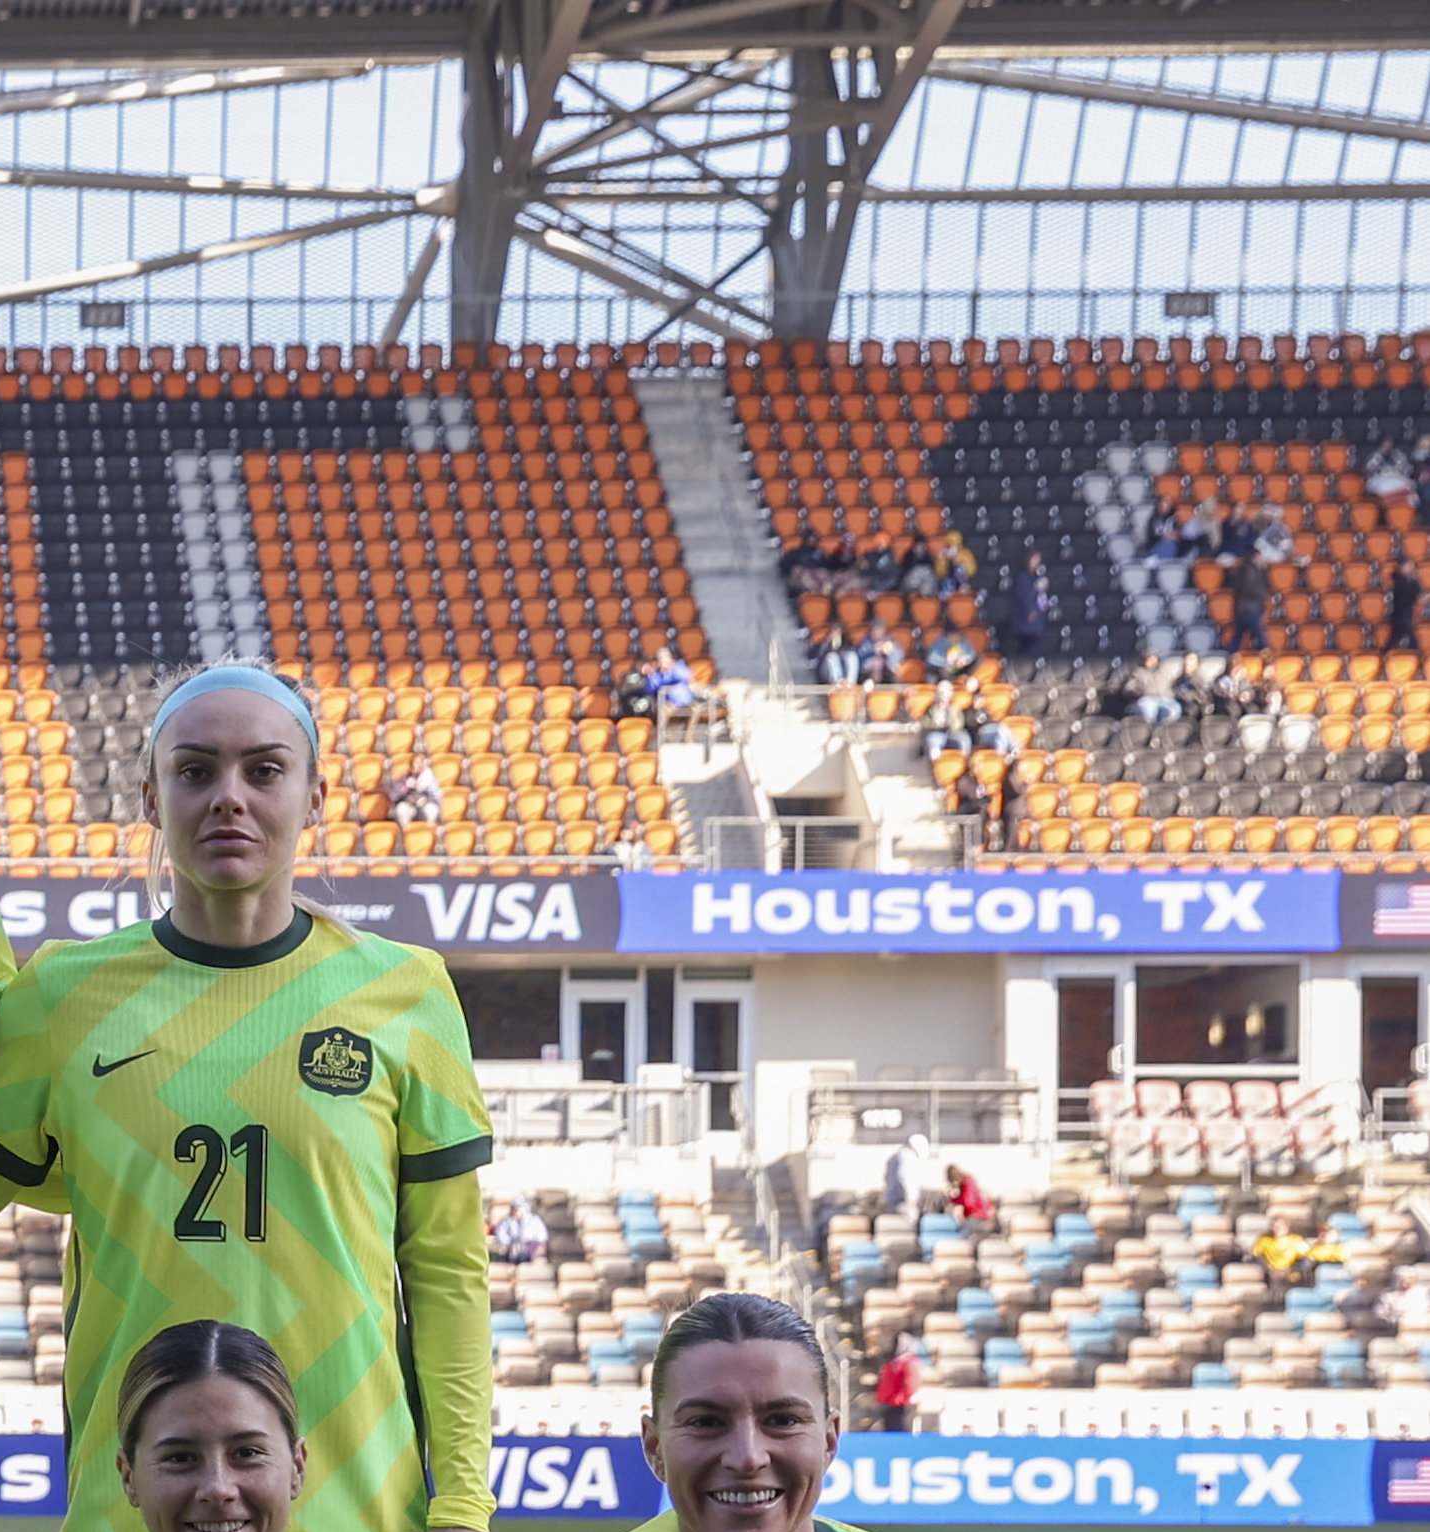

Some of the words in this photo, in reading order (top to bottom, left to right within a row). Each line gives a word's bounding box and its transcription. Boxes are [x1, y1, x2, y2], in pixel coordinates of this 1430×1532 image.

[409, 883, 583, 941] VISA
[692, 882, 1121, 941] Houston,
[1143, 881, 1266, 932] TX
[312, 1067, 360, 1079] AUSTRALIA
[174, 1124, 268, 1242] 21
[821, 1451, 1159, 1514] ouston,
[1177, 1453, 1302, 1506] TX
